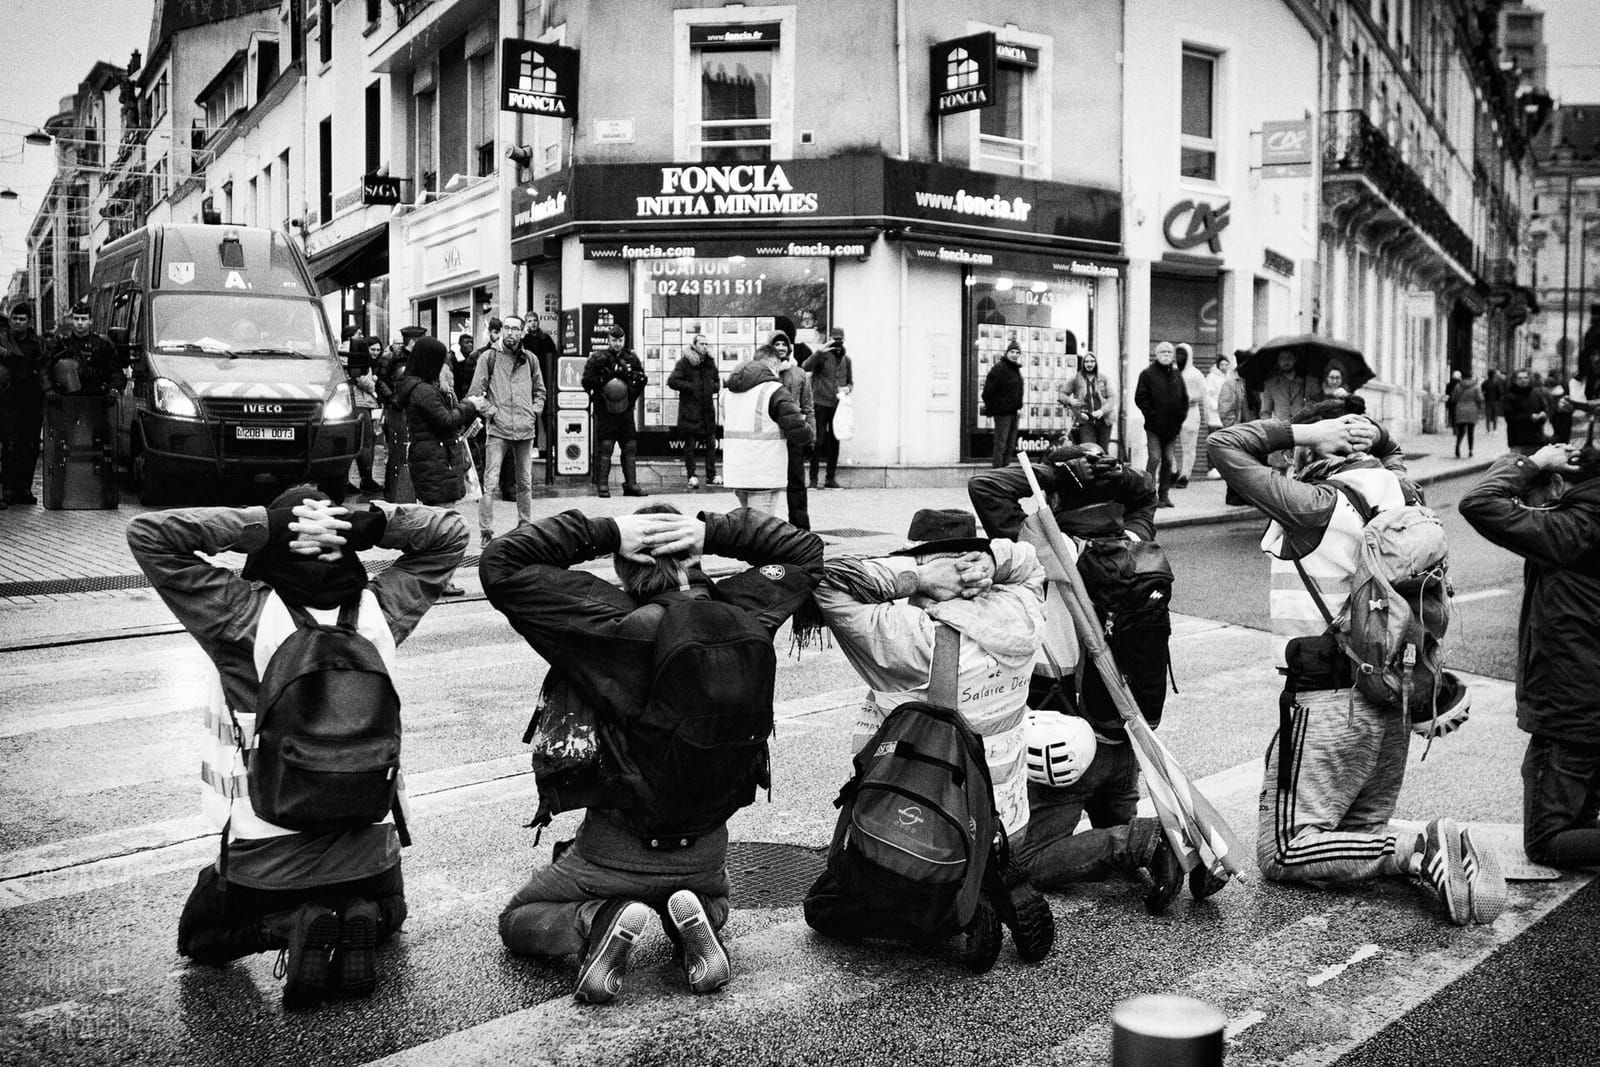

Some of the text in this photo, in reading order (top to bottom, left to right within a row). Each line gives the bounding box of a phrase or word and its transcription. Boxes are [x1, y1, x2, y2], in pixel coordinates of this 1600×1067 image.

[508, 92, 566, 113] FONCIA
[940, 89, 987, 110] FONCIA
[660, 164, 793, 194] FONCIA
[636, 193, 818, 216] INITIA MINIMES
[915, 189, 1031, 221] www.foncia.fr
[591, 244, 696, 258] www.foncia.com
[756, 242, 865, 256] www.foncia.com
[917, 247, 993, 265] www.foncia.com
[1052, 261, 1119, 278] www.foncia.com
[658, 279, 762, 296] 02 43 511 511
[243, 404, 283, 413] IVECO
[961, 685, 1005, 703] Salaire
